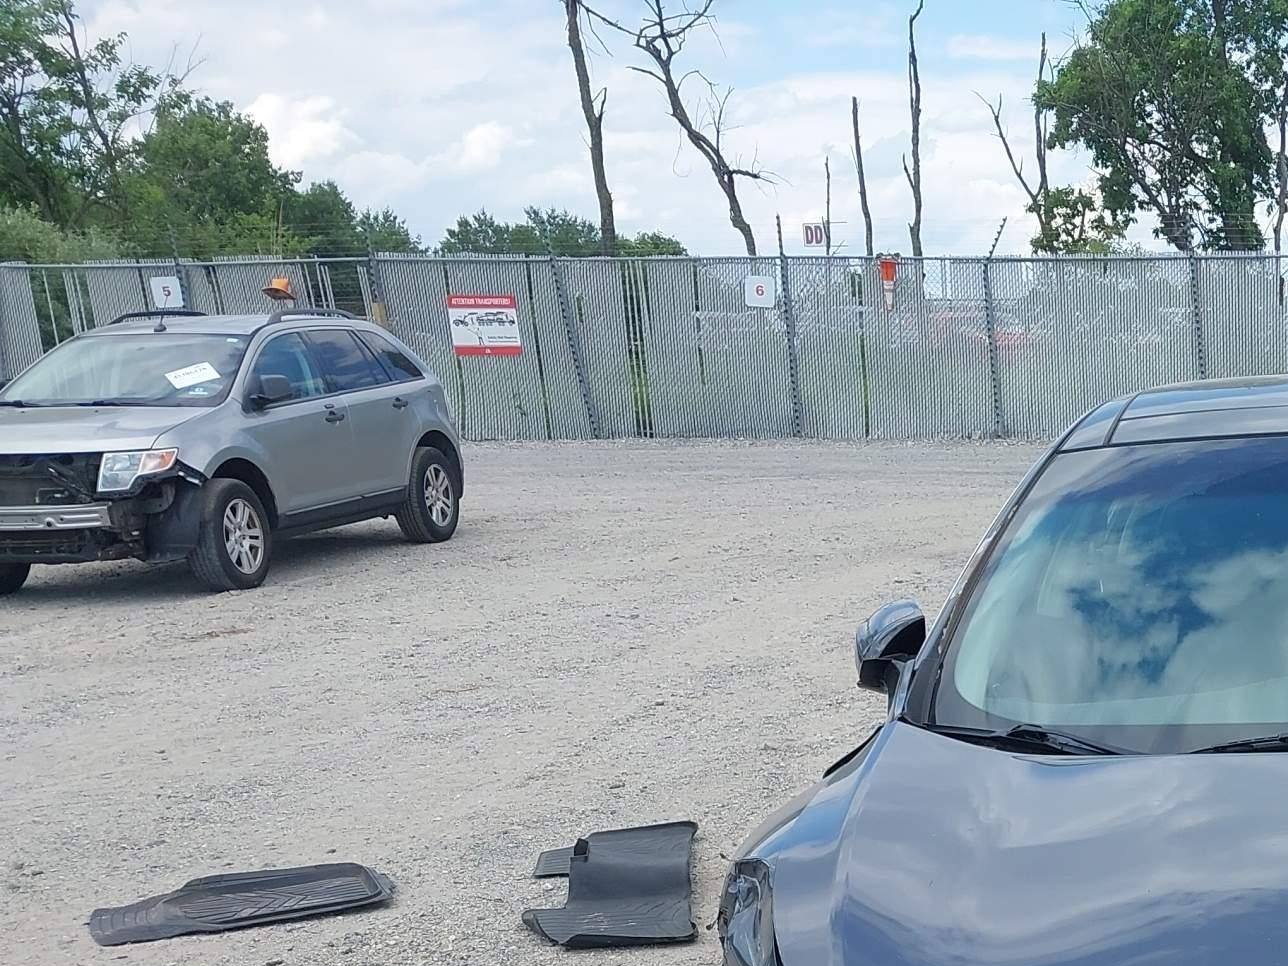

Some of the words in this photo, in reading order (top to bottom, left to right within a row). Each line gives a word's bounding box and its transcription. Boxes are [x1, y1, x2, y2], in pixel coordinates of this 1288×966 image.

[804, 225, 823, 245] DD
[162, 286, 172, 297] 5
[755, 284, 765, 297] 6
